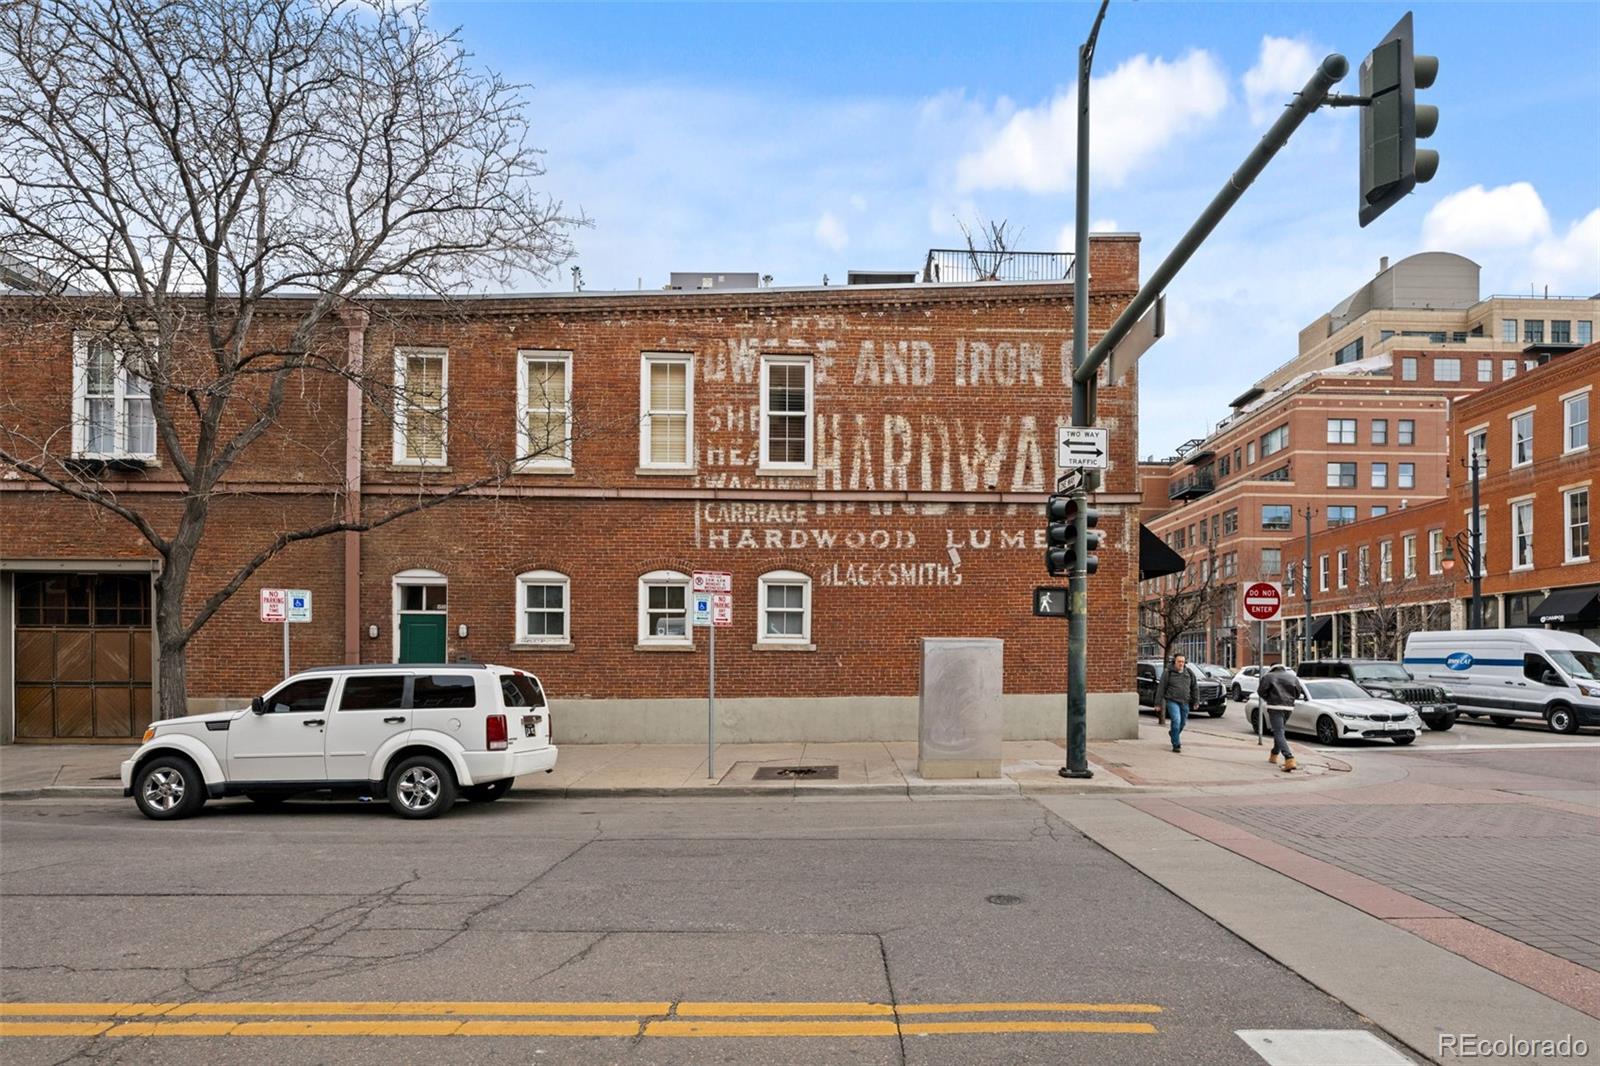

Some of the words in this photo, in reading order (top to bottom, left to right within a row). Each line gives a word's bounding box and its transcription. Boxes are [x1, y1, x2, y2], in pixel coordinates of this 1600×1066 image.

[853, 340, 937, 387] AND
[955, 337, 1044, 388] IRON
[816, 412, 1121, 516] HARDWA
[704, 502, 808, 523] CARRIAGE
[708, 528, 916, 549] HARDWOOD
[946, 528, 1108, 549] LUMR
